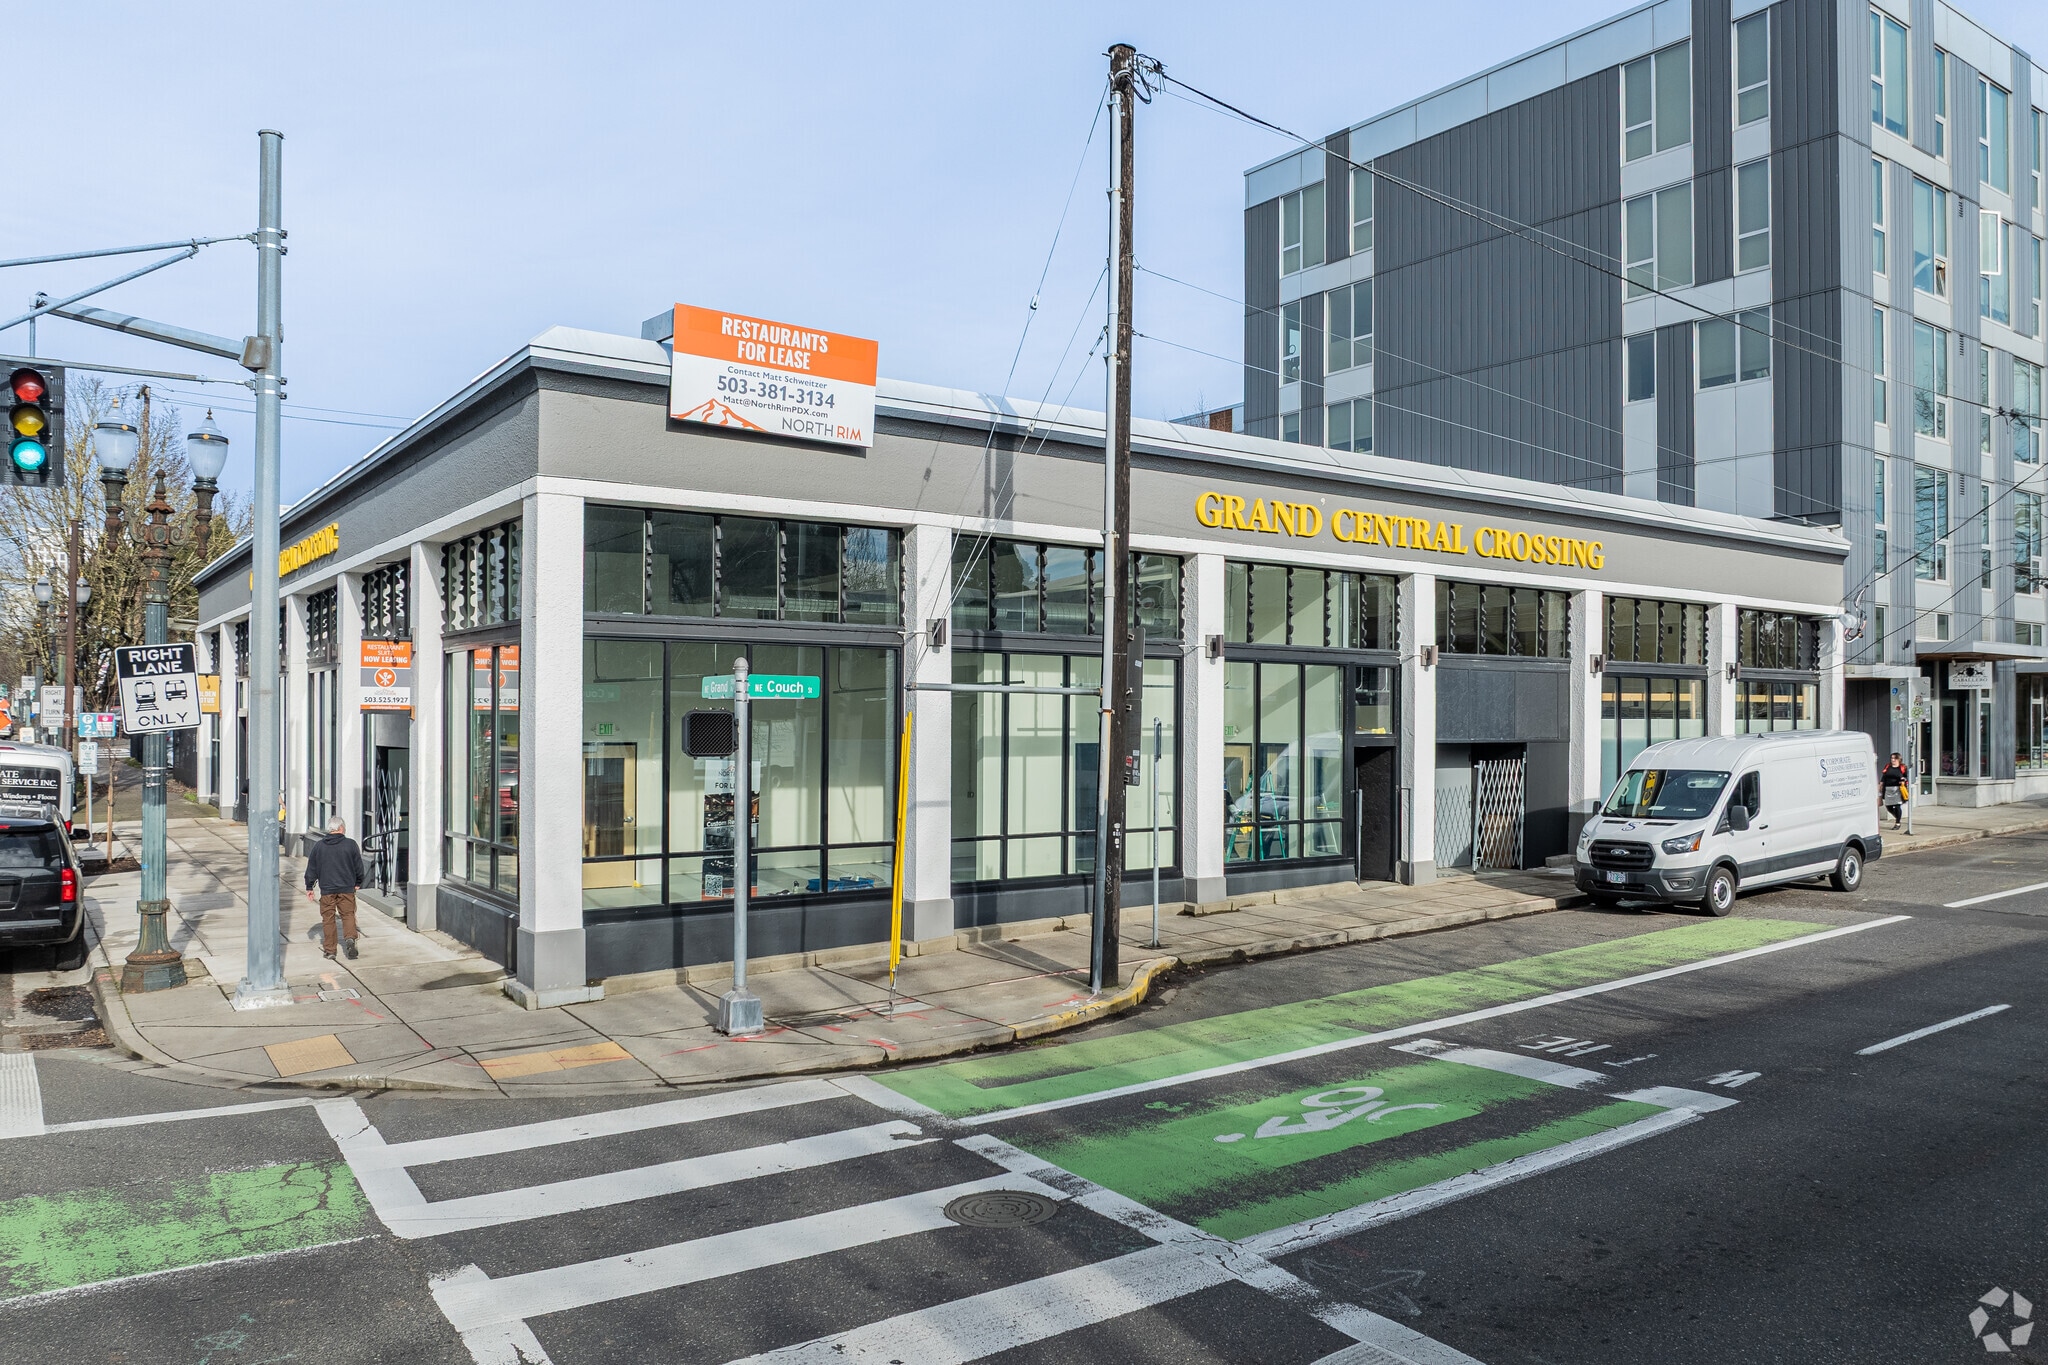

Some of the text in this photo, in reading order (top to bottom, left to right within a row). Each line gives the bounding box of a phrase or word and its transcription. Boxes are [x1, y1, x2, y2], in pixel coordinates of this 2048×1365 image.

[721, 316, 828, 354] RESTAURANTS
[737, 340, 811, 370] FOR LEASE
[727, 365, 828, 389] Contact Matt Schweitzer
[717, 375, 835, 409] 503-381-3134
[723, 395, 829, 419] Matt@NorthRimPDX.com
[781, 417, 862, 442] NORTH RIM
[1195, 491, 1606, 570] GRAND CENTRAL CROSSING
[128, 647, 183, 662] RIGHT
[381, 656, 408, 664] LEASING
[132, 661, 183, 676] LANE
[710, 681, 728, 693] Grand
[755, 683, 763, 692] NE
[767, 680, 804, 693] Couch
[138, 712, 188, 726] ONLY
[599, 723, 613, 734] EXIT
[1826, 756, 1851, 765] CORPORATE
[2, 778, 39, 786] SERVICE
[2, 792, 31, 800] Windows
